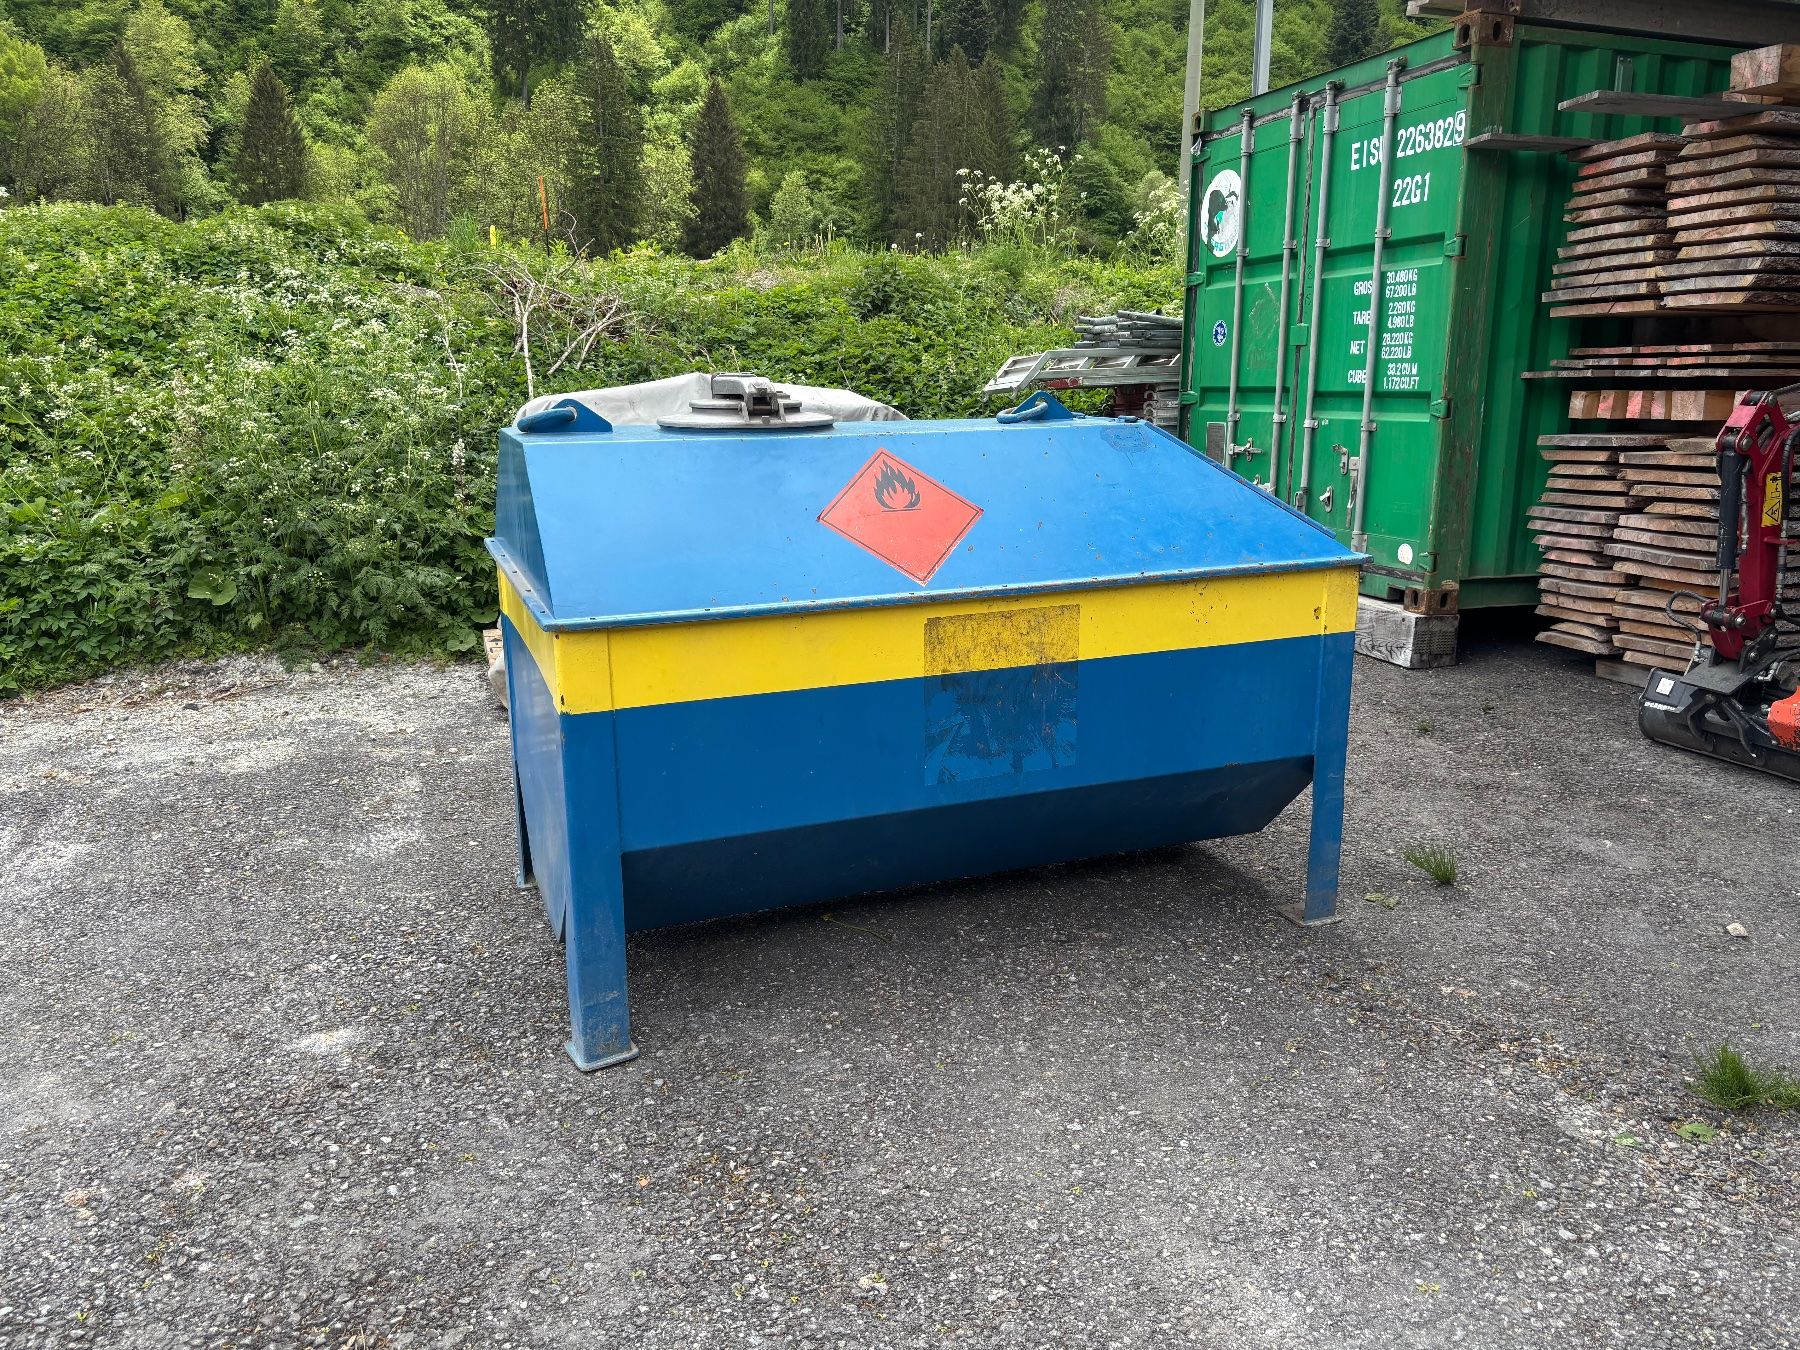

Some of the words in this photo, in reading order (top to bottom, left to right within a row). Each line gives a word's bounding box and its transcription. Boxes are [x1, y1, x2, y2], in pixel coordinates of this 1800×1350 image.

[1397, 110, 1466, 158] 2263829
[1392, 172, 1431, 208] 22G1
[1349, 340, 1366, 355] NET
